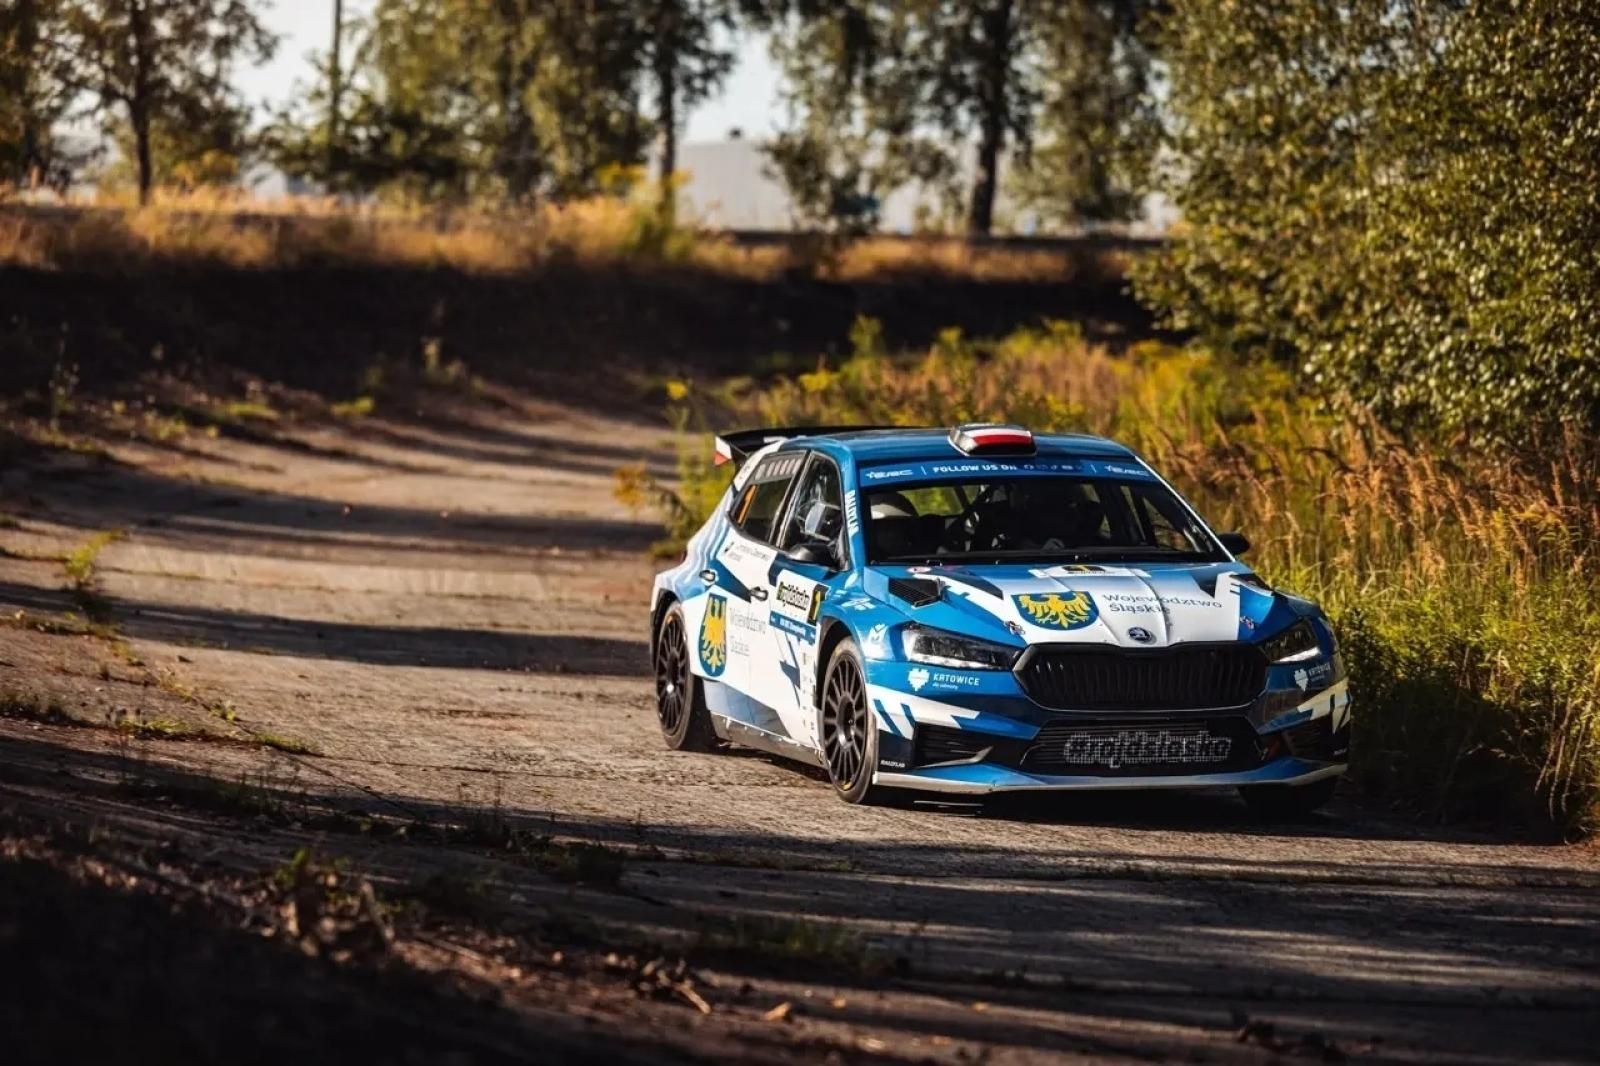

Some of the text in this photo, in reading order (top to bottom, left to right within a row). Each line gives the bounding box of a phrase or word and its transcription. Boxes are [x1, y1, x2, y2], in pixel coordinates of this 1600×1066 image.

[932, 464, 979, 473] FOLLOW
[981, 463, 998, 471] US
[1102, 593, 1222, 609] Województwo
[1109, 602, 1171, 616] Śląskie
[932, 672, 980, 687] KATOWICE
